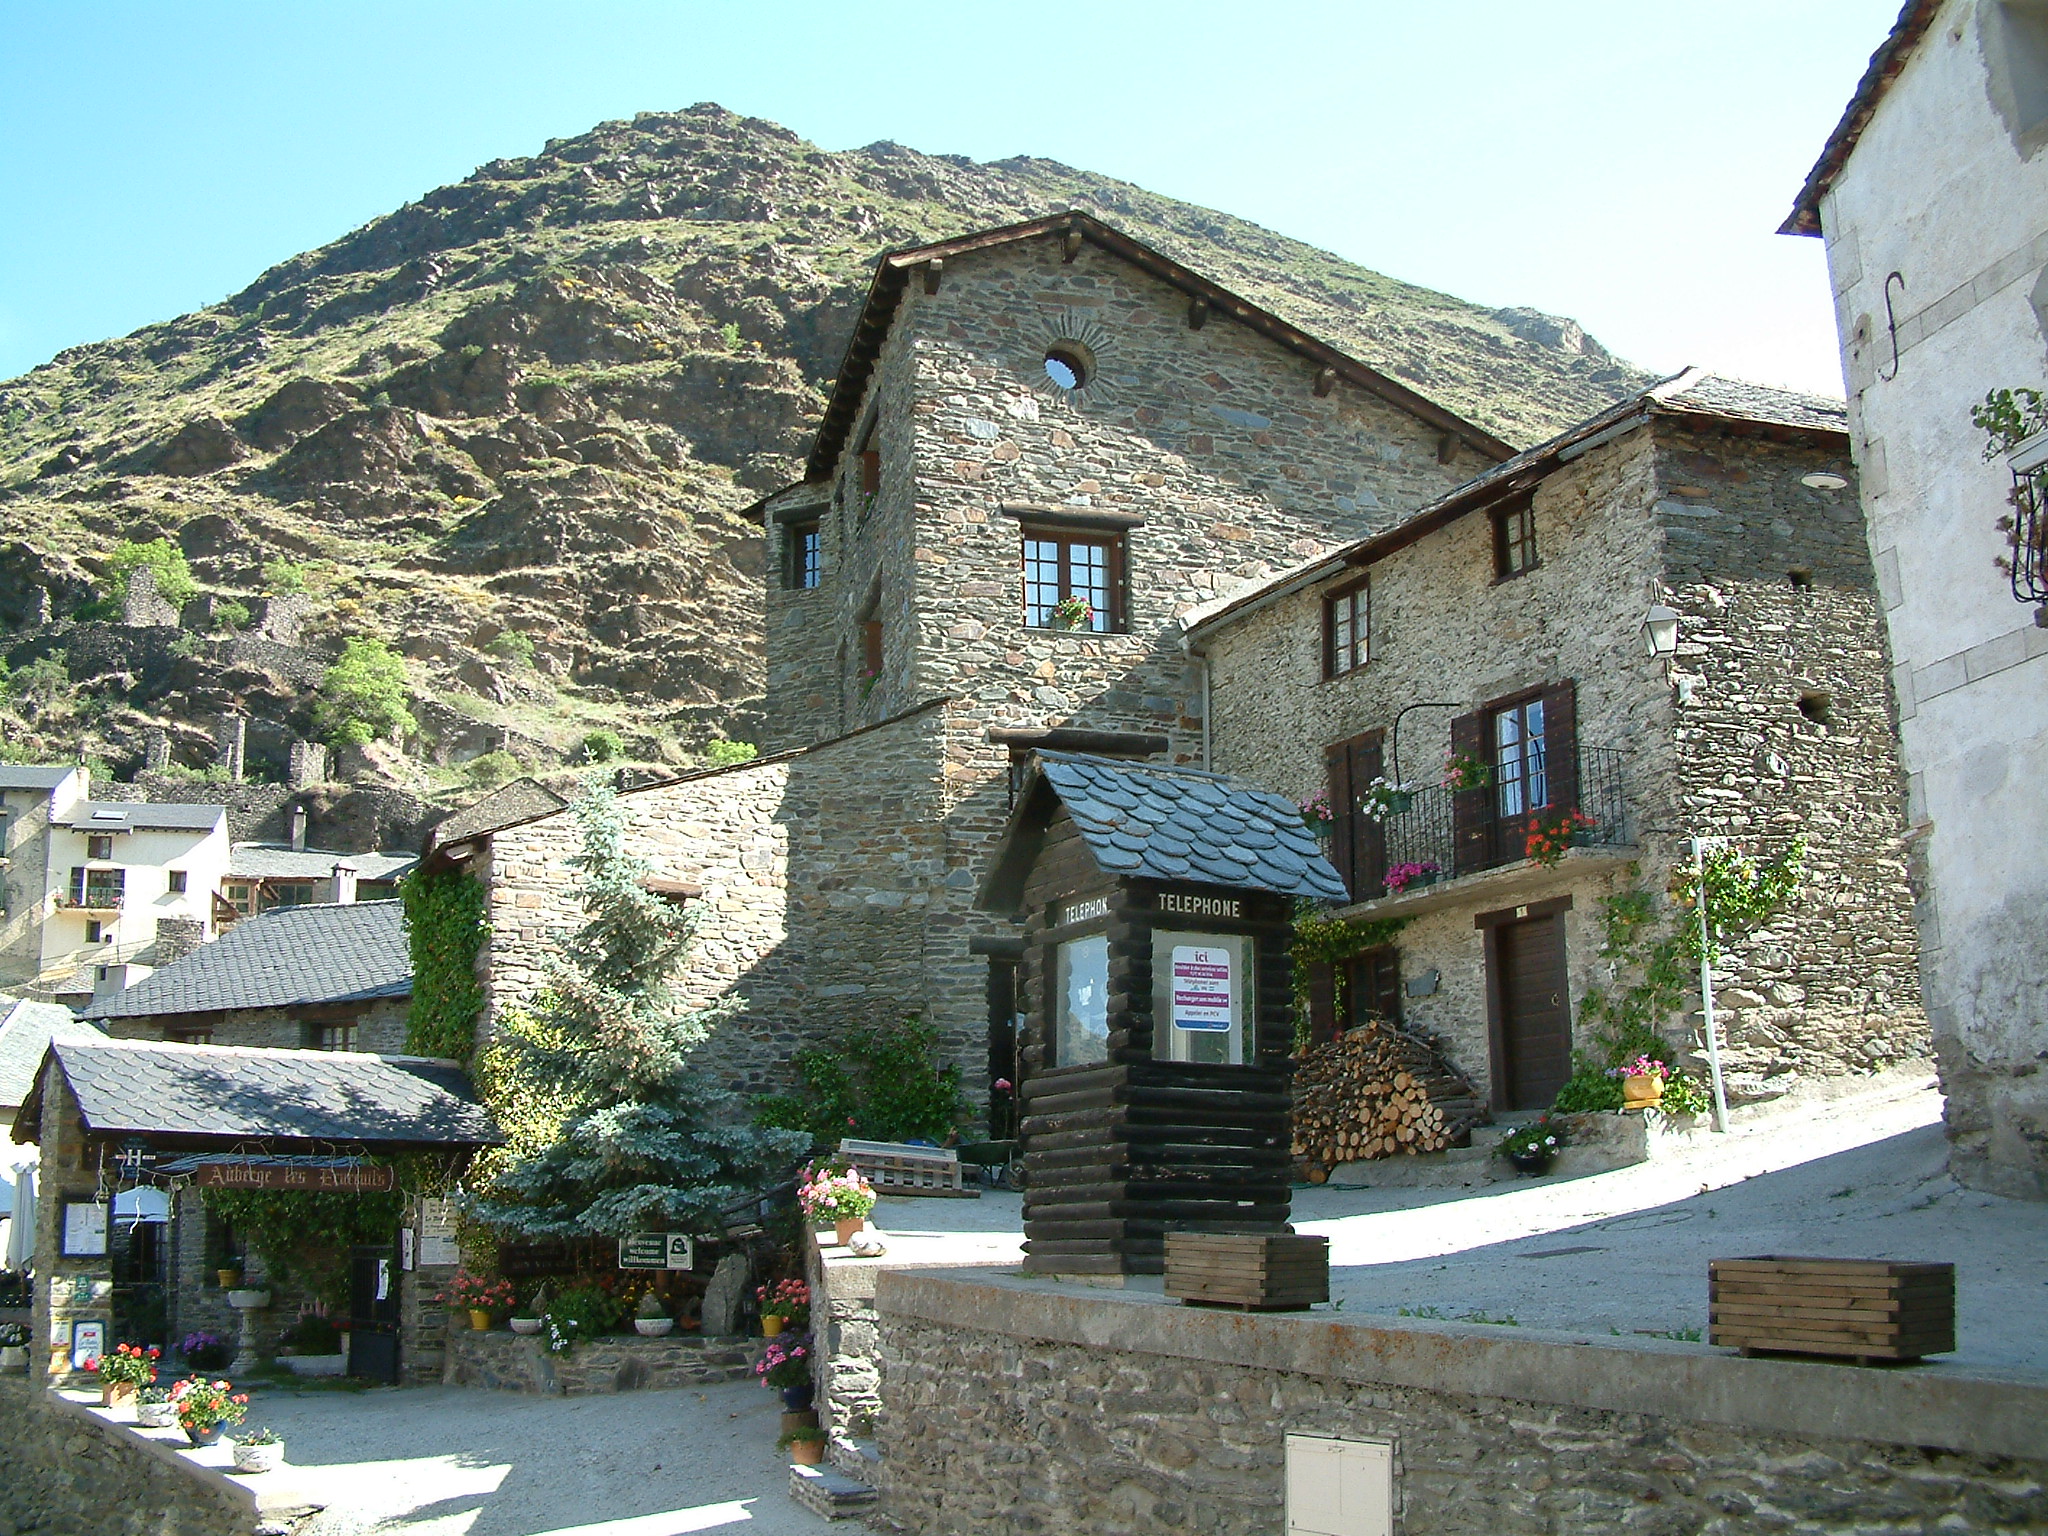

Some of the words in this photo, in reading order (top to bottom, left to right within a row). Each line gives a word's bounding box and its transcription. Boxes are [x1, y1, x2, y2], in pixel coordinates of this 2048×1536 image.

[1065, 896, 1112, 924] TELEPHON
[1158, 893, 1240, 918] TELEPHONE
[1195, 951, 1208, 963] ici
[208, 1165, 272, 1188] Auberge
